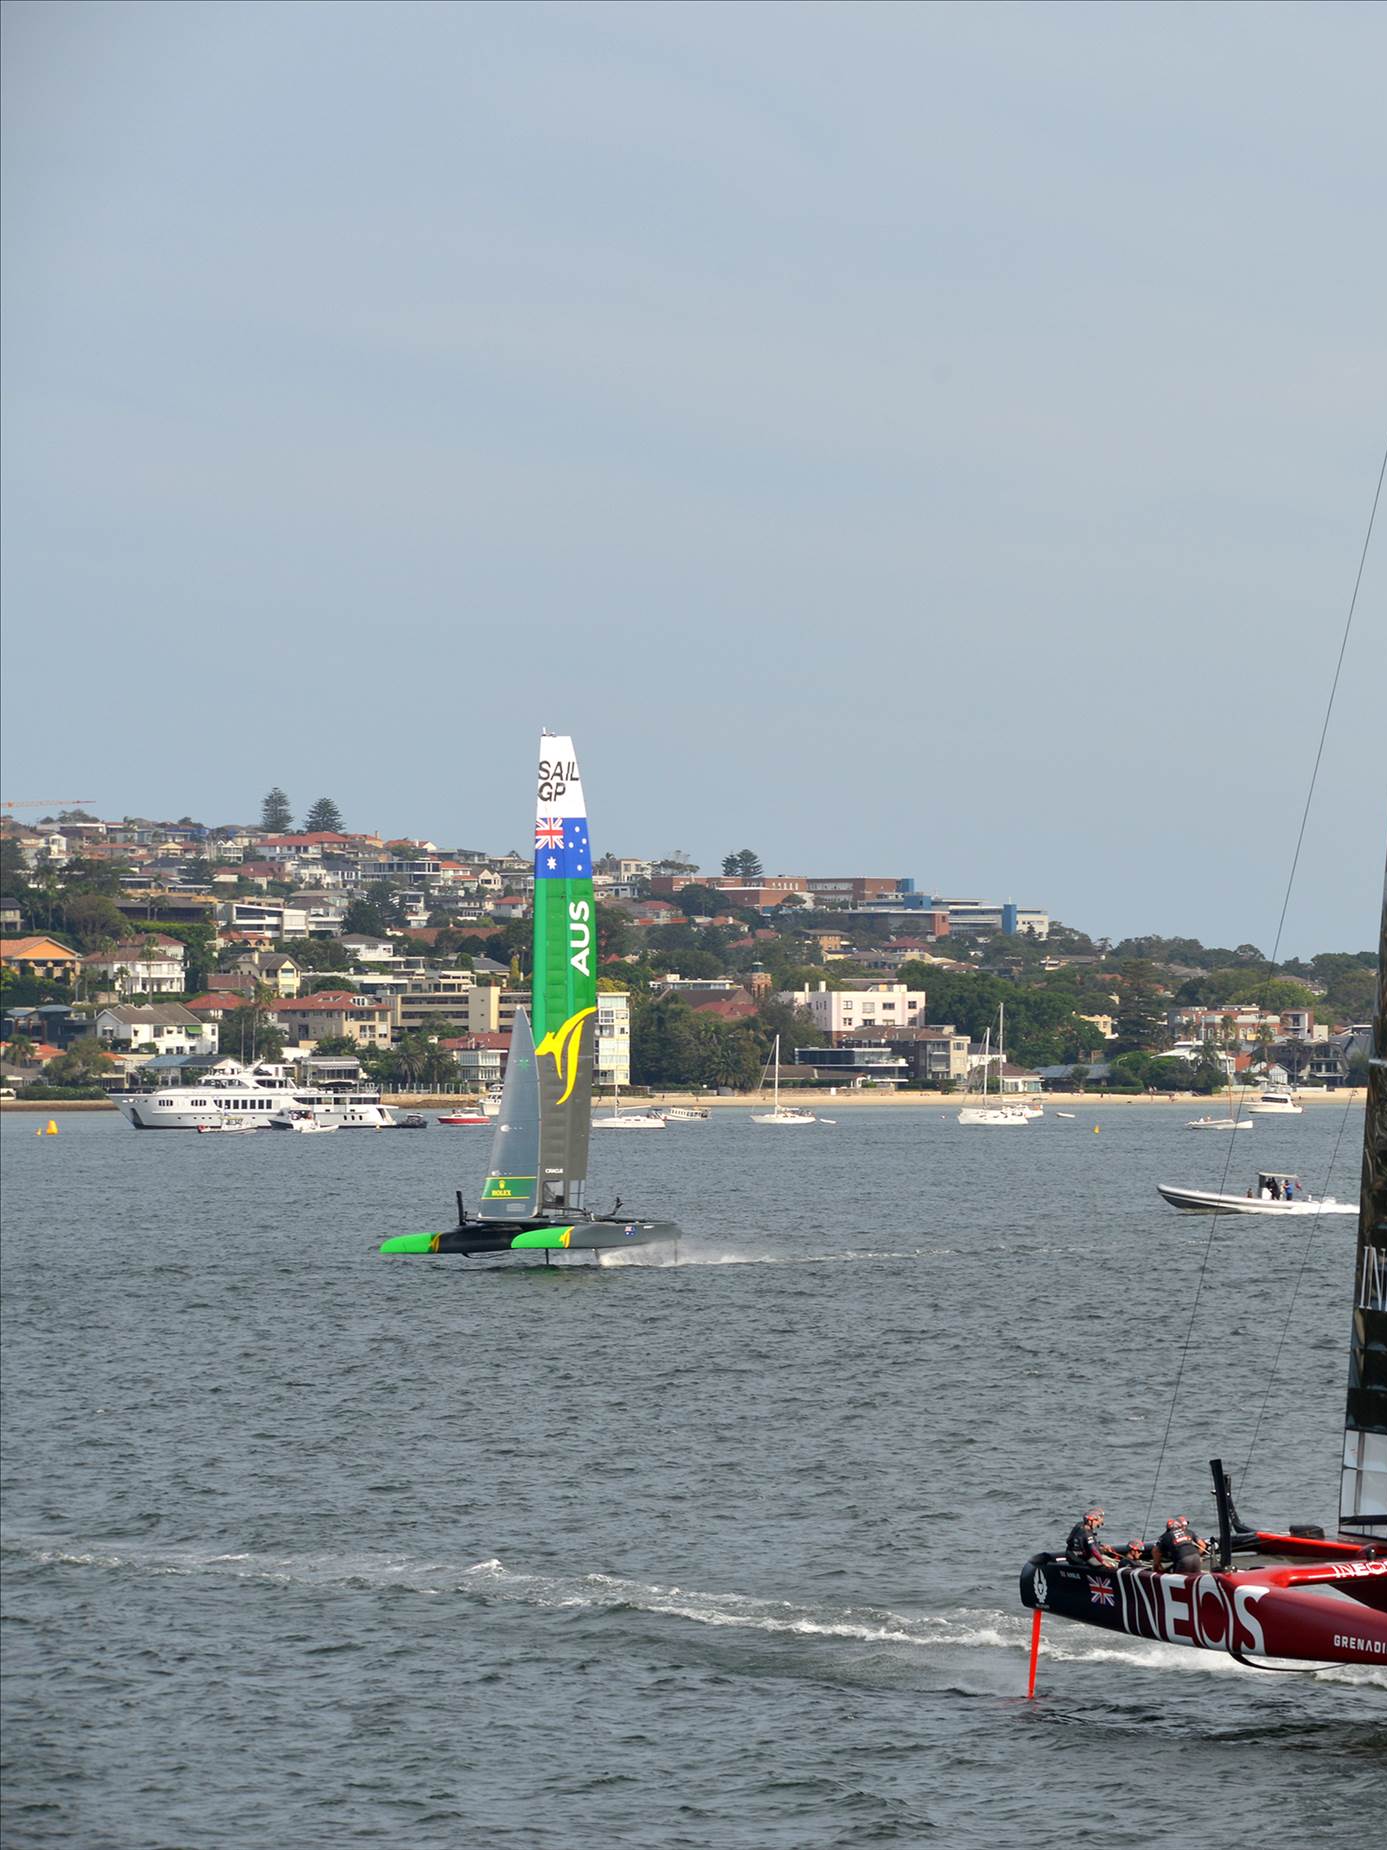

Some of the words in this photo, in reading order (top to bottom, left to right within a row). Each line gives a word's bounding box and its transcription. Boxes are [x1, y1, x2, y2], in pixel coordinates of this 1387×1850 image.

[537, 760, 580, 782] SAIL
[537, 782, 566, 802] GP
[568, 900, 590, 976] AUS
[1117, 1566, 1271, 1657] INEOS
